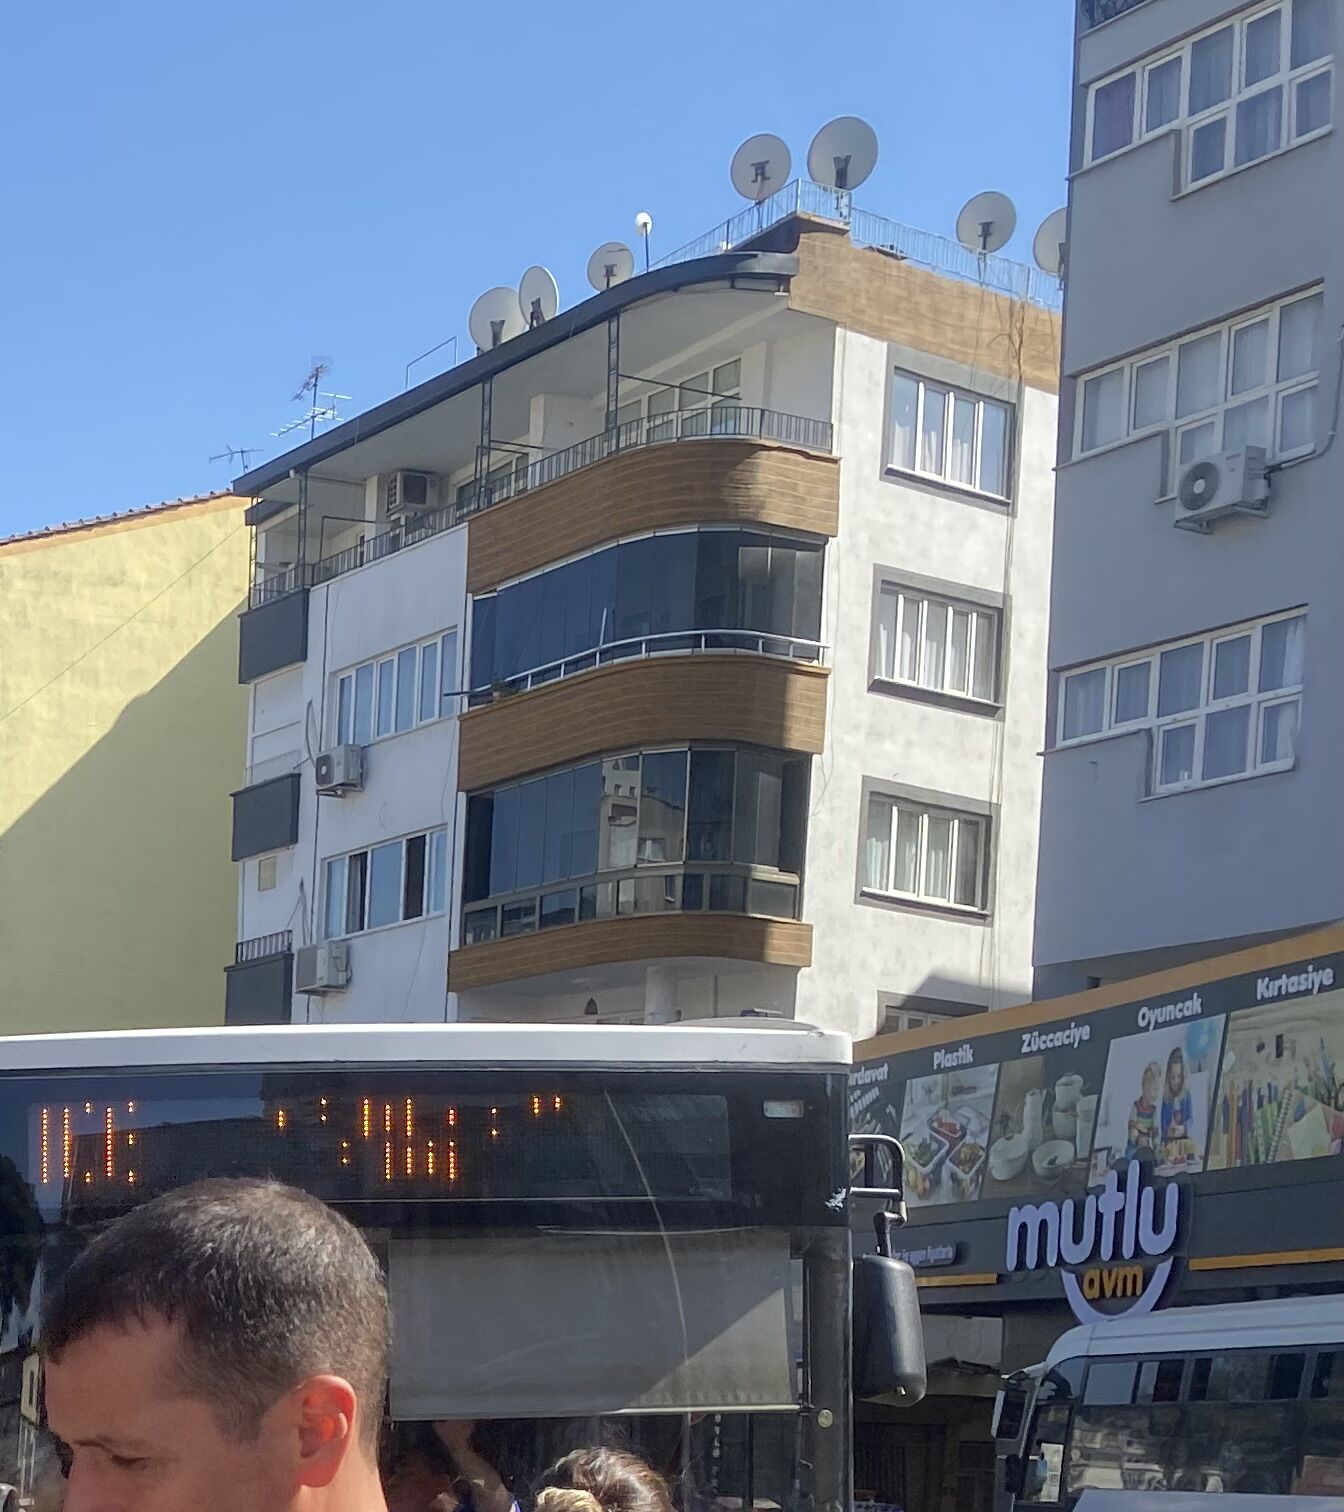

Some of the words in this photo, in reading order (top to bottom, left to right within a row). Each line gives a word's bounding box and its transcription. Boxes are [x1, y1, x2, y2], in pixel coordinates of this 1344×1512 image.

[1256, 965, 1334, 1001] Kırtasiye
[1137, 992, 1202, 1032] Oyuncak
[1020, 1021, 1091, 1054] Züccaciye
[933, 1044, 974, 1071] Plastik
[1005, 1159, 1179, 1271] mutlu
[1083, 1265, 1143, 1300] avm
